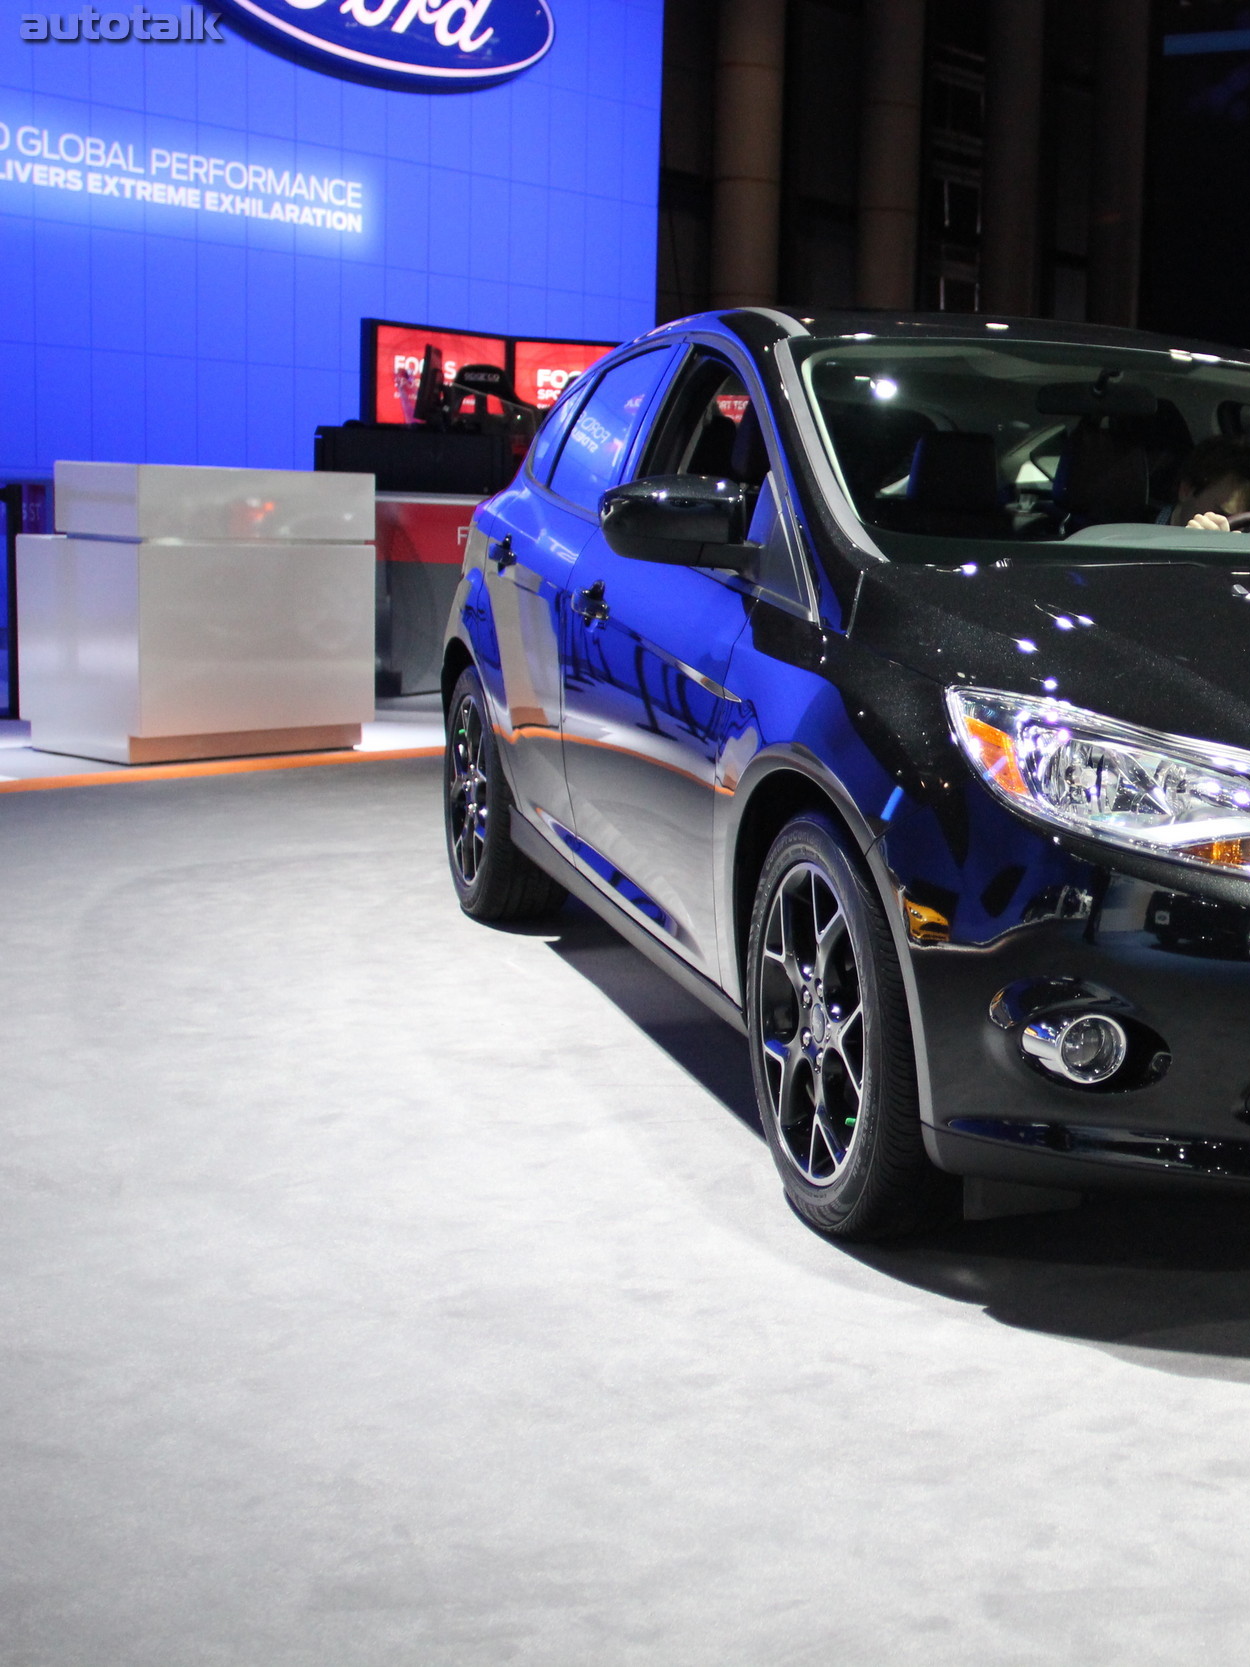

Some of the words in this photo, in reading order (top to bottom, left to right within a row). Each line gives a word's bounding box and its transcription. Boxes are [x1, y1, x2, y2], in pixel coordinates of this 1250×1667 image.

[0, 160, 83, 191] IVERS
[87, 172, 201, 210] EXTREME
[204, 192, 363, 234] EXHILARATION
[16, 125, 145, 174] GLOBAL
[150, 147, 363, 208] PERFORMANCE
